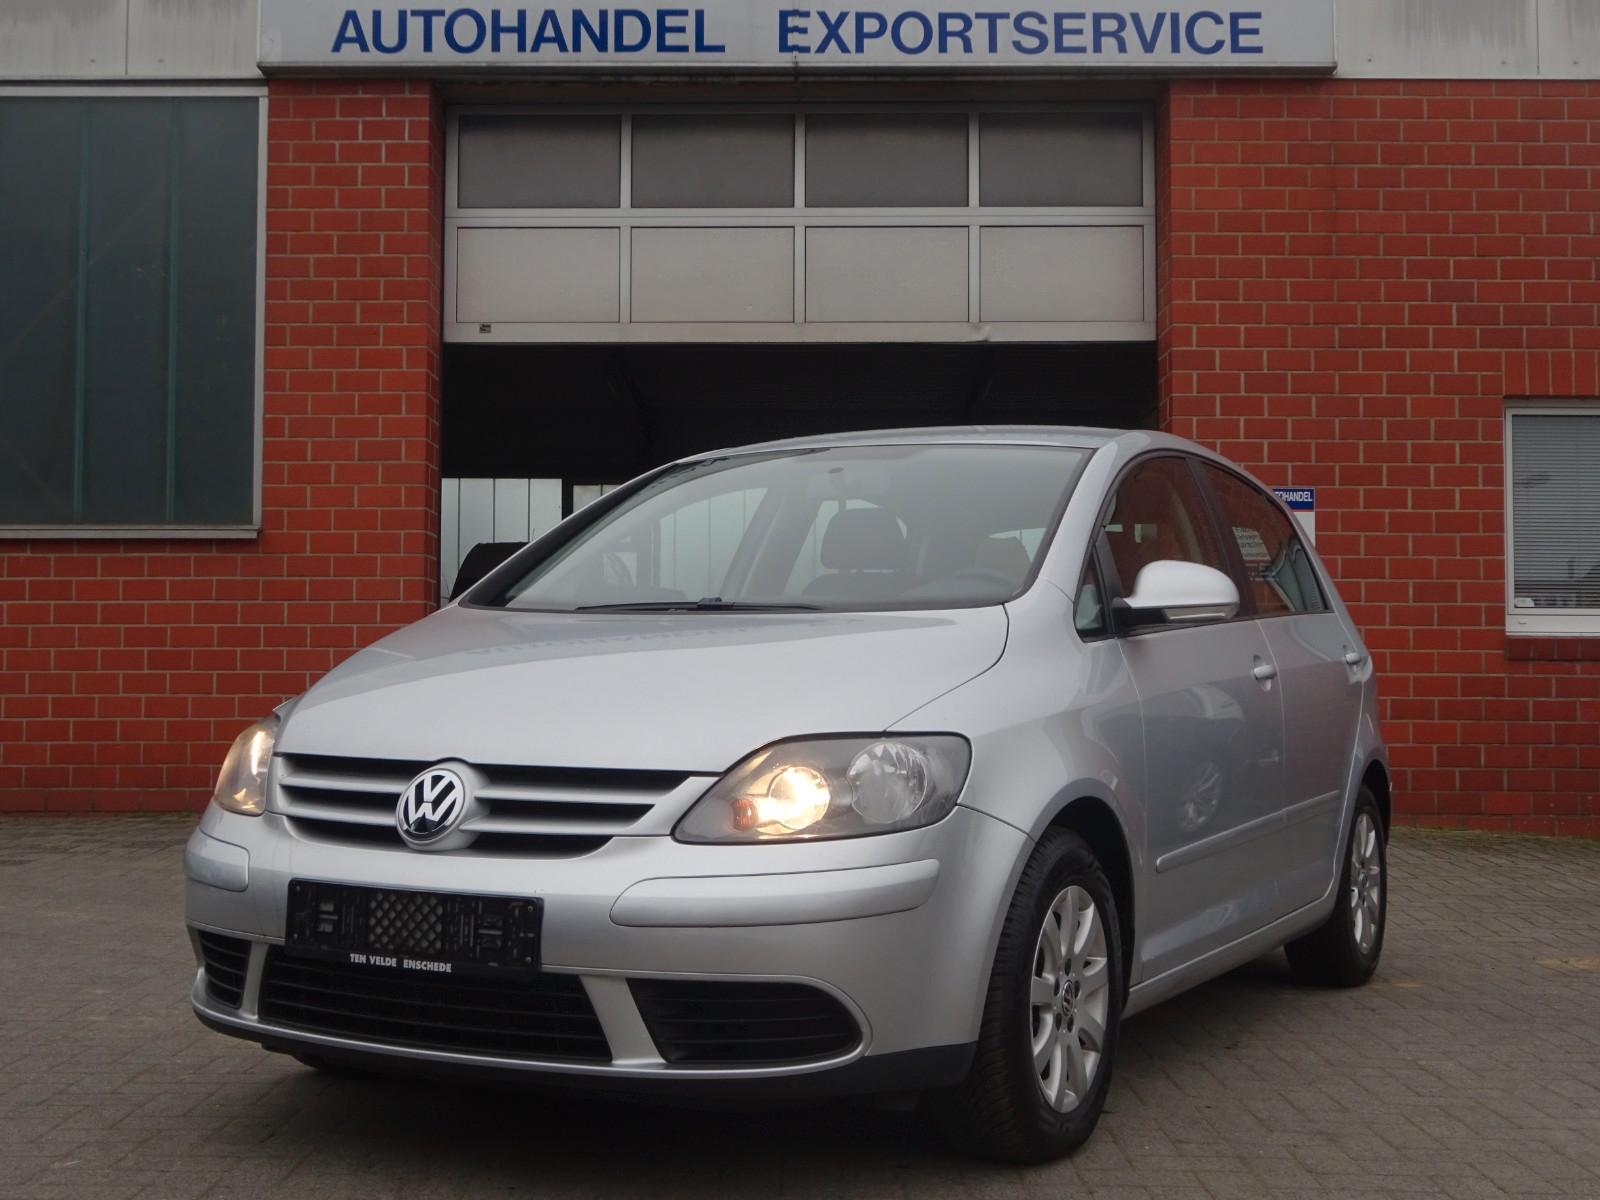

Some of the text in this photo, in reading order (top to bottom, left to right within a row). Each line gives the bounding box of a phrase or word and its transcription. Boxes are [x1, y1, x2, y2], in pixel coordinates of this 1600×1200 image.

[331, 8, 1263, 54] AUTOHANDEL EXPORTSERVICE
[401, 770, 463, 838] VW
[350, 953, 452, 973] TEN VELDE ENSCHEDE
